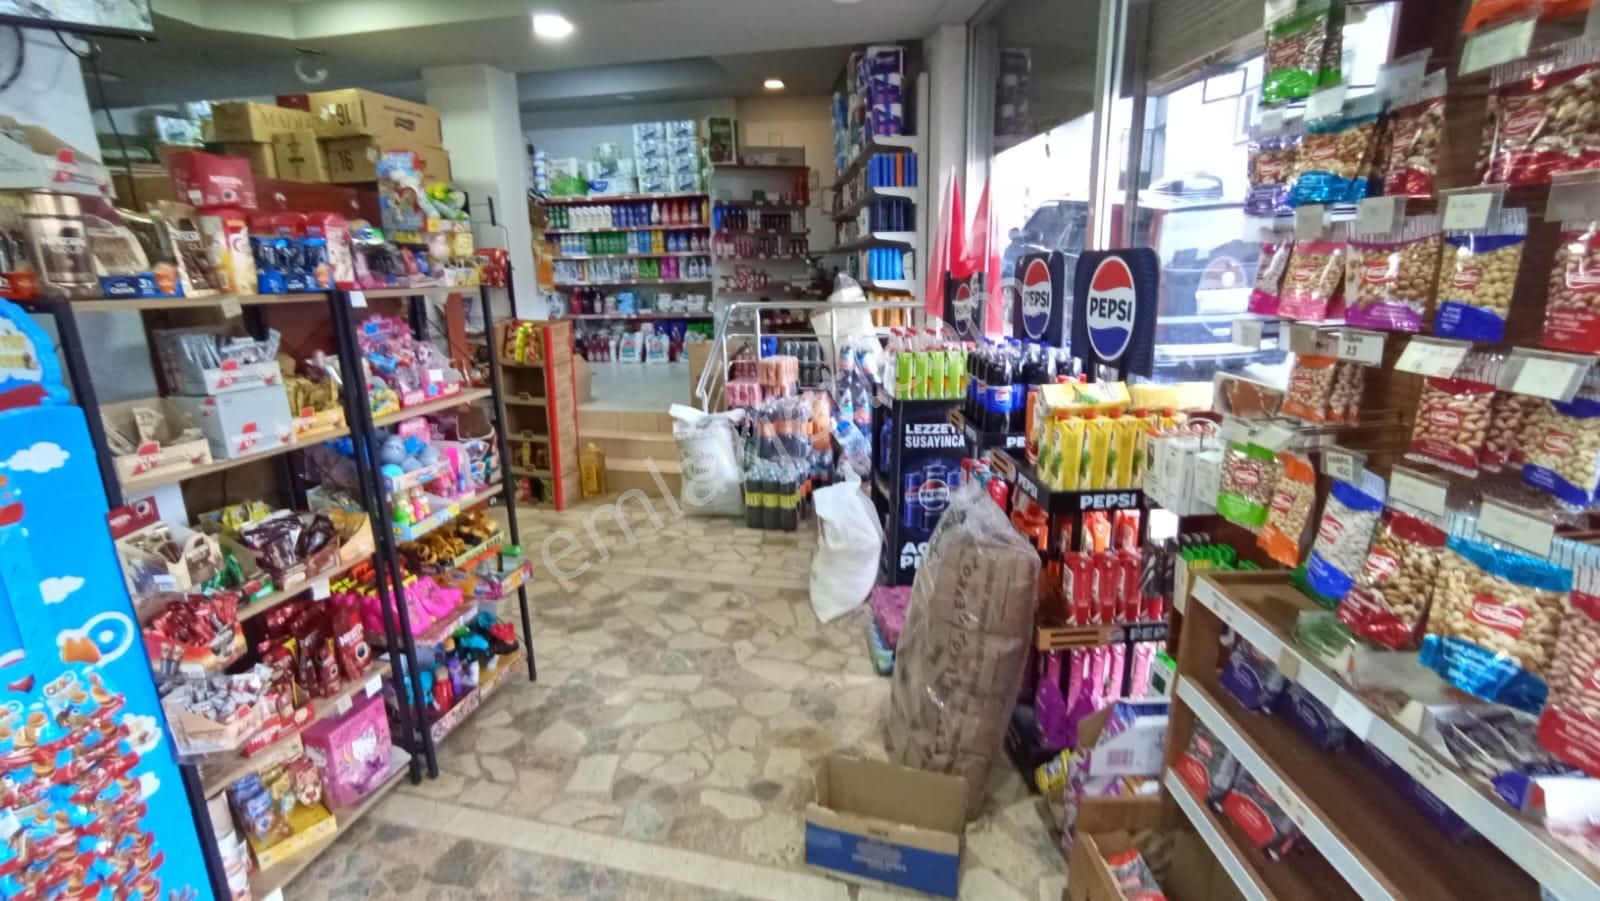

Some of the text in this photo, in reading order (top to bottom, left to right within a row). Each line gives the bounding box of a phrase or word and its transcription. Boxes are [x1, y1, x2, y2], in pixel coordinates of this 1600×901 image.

[1022, 291, 1050, 308] PEPSI
[1089, 297, 1131, 323] PEPSI
[905, 423, 961, 434] LEZZET
[905, 434, 965, 448] SUSAYINCA
[1017, 471, 1038, 500] PEPSI
[1080, 493, 1137, 510] PEPSI
